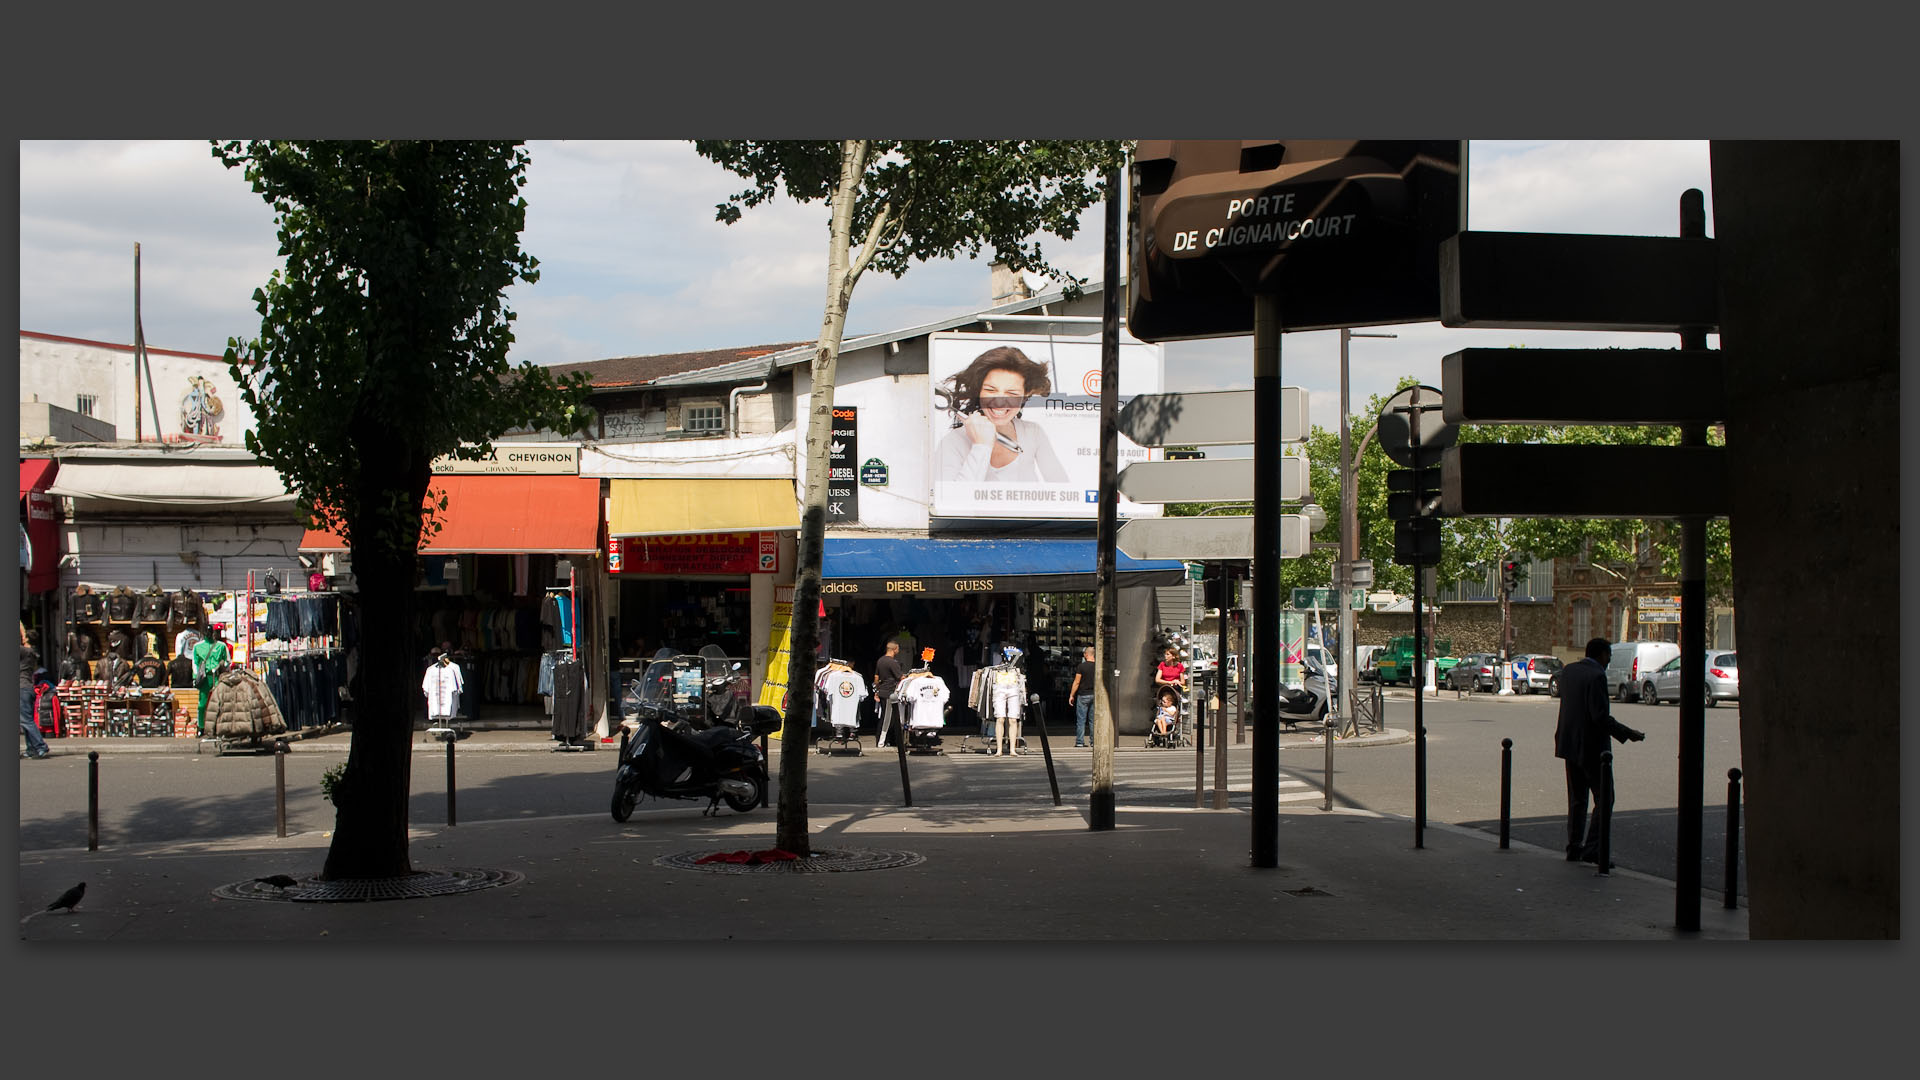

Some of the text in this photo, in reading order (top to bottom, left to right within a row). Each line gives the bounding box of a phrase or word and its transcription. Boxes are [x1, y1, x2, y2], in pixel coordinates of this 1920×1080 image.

[1227, 193, 1295, 219] PORTE
[1173, 214, 1356, 251] DE CLIGNANCOURT
[1045, 398, 1101, 411] Maste
[508, 453, 572, 462] CHEVIGNON
[435, 464, 454, 472] ecko
[832, 467, 855, 478] DIESEL
[828, 488, 851, 497] UESS
[974, 489, 989, 500] ON
[990, 489, 1003, 501] SE
[1006, 490, 1057, 502] RETROUVE
[1060, 490, 1080, 502] SUR
[609, 543, 623, 552] SFR
[761, 543, 774, 552] SFR
[886, 581, 926, 592] DIESEL
[954, 579, 994, 591] GUESS
